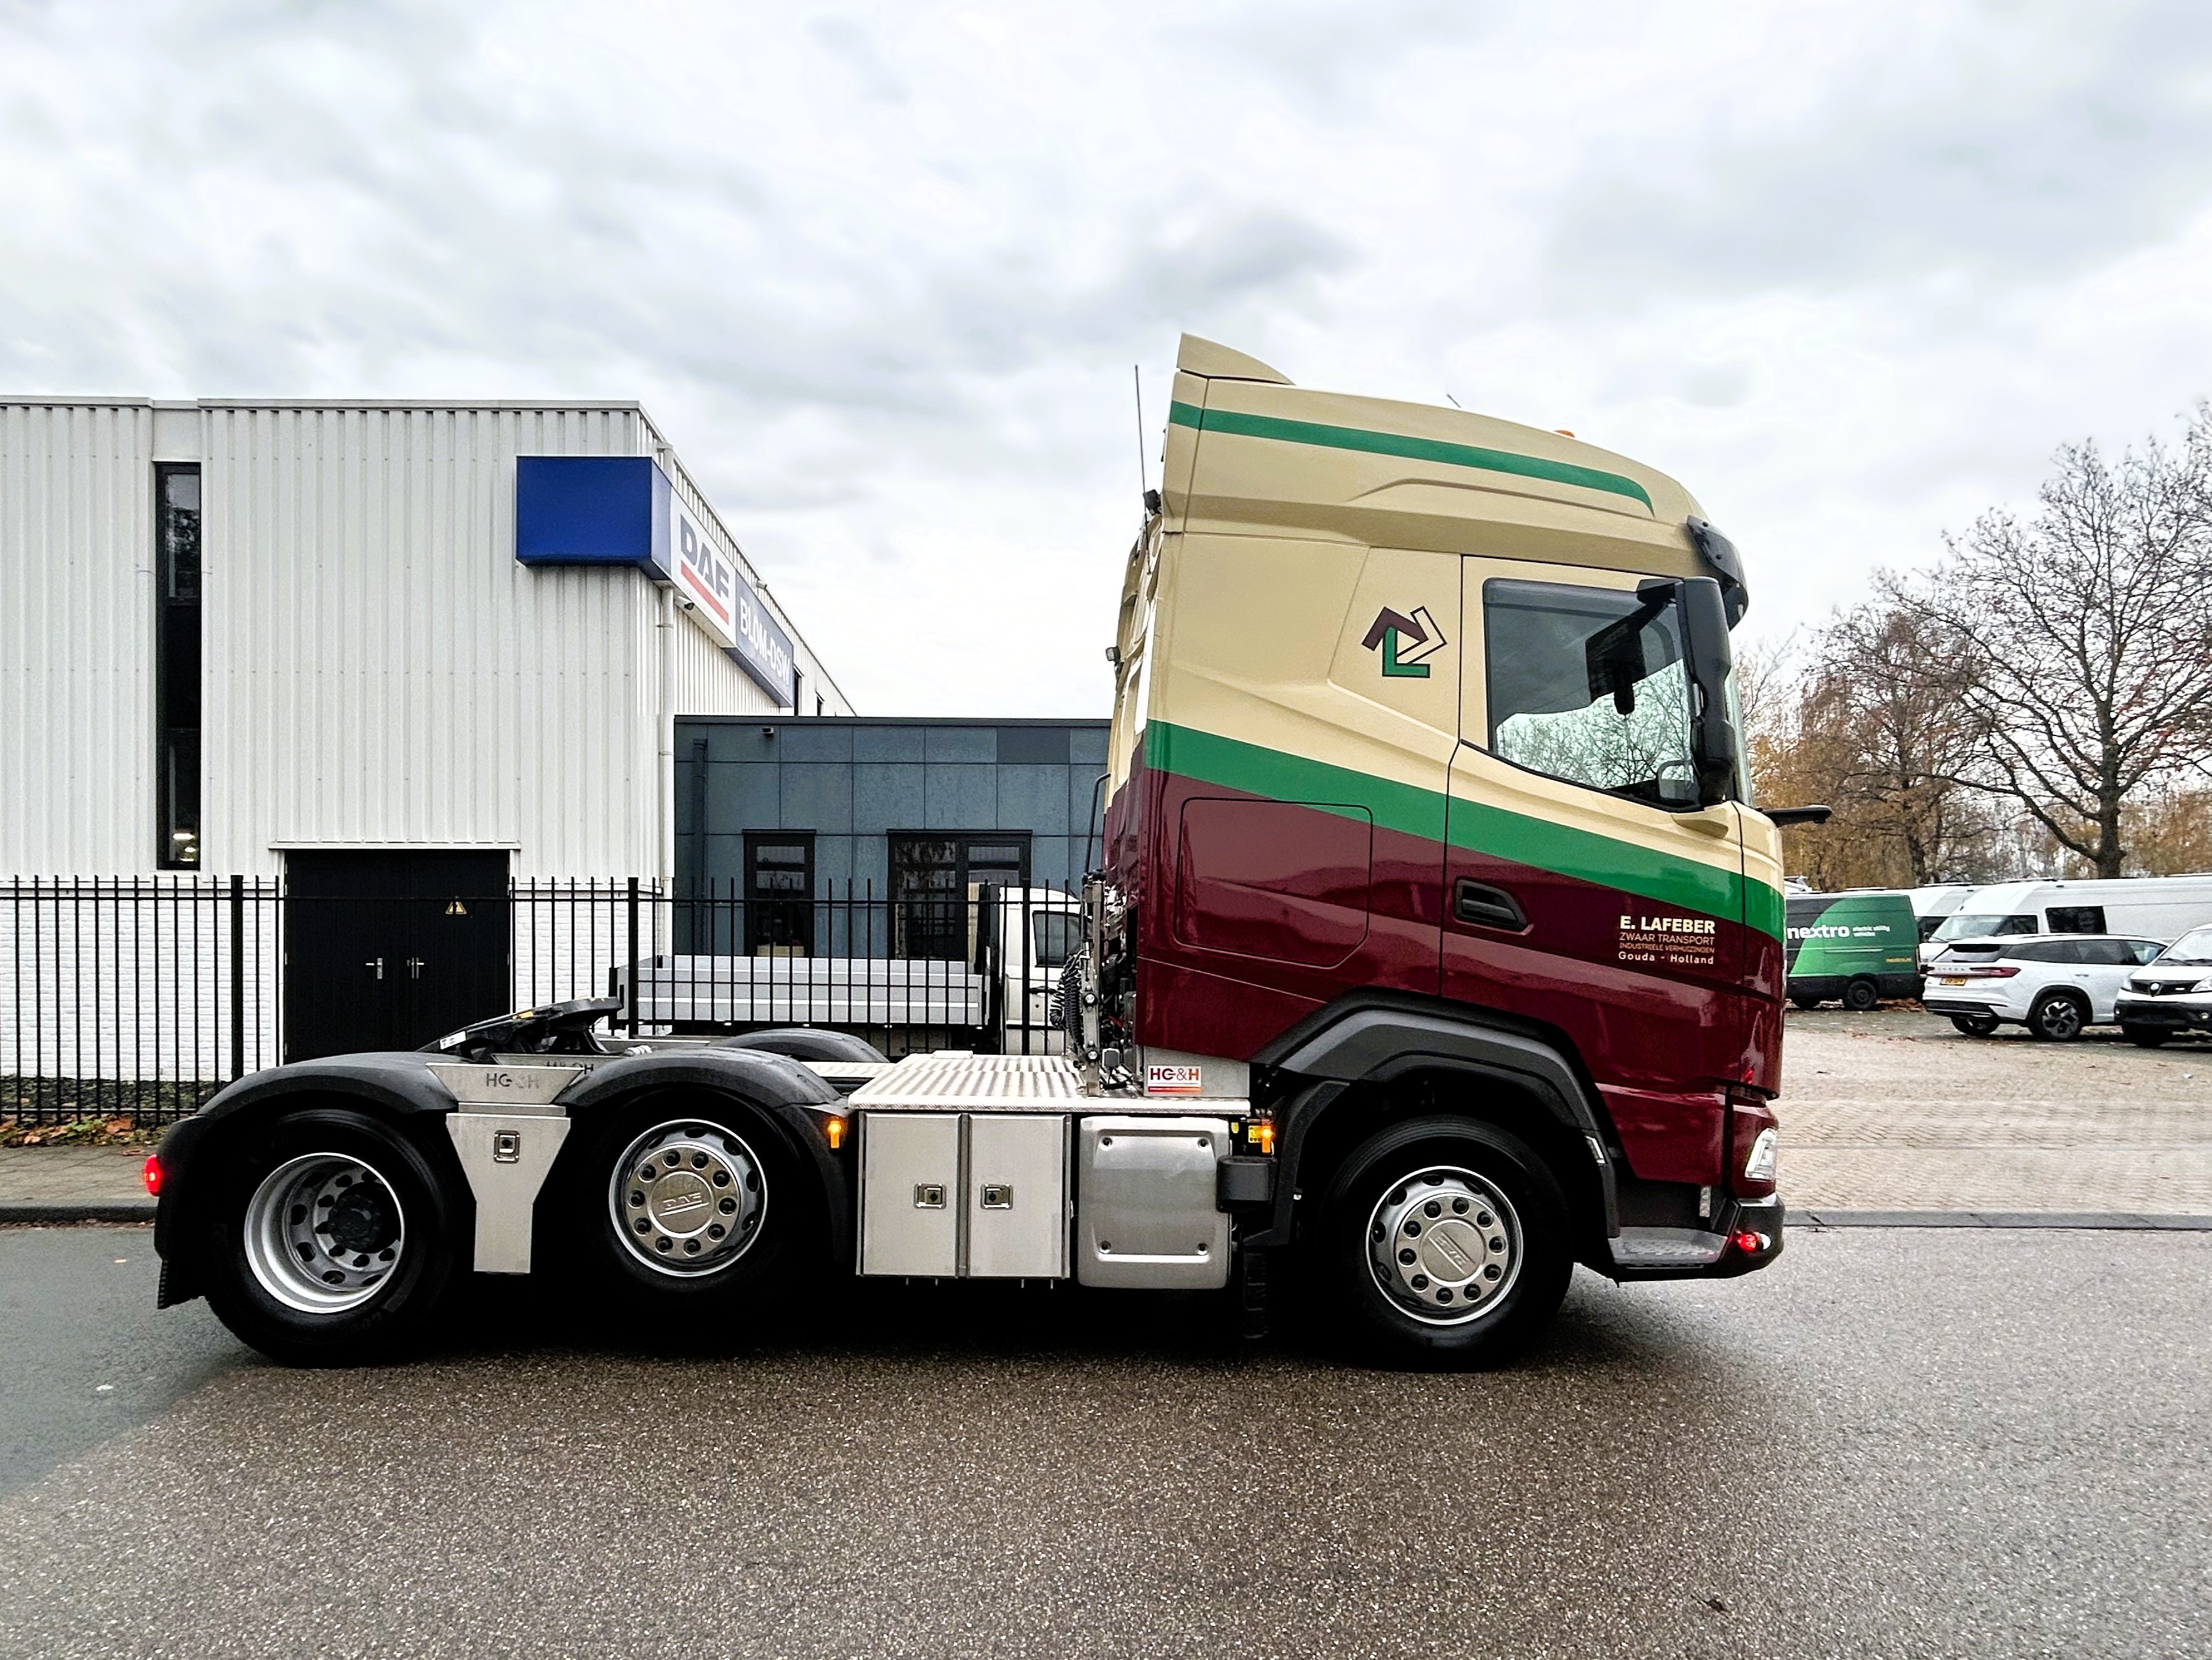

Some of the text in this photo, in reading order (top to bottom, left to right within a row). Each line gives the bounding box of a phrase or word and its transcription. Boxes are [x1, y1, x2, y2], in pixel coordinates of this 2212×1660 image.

[680, 514, 729, 598] DAF
[739, 597, 791, 685] BLOM-DSW
[1620, 915, 1715, 934] E. LAFEBER
[1619, 932, 1715, 945] ZWAAR TRANSPORT
[1787, 925, 1850, 939] nextro
[1618, 951, 1655, 962] Gouda
[1670, 954, 1714, 965] Holland
[1150, 1067, 1199, 1081] HG&H
